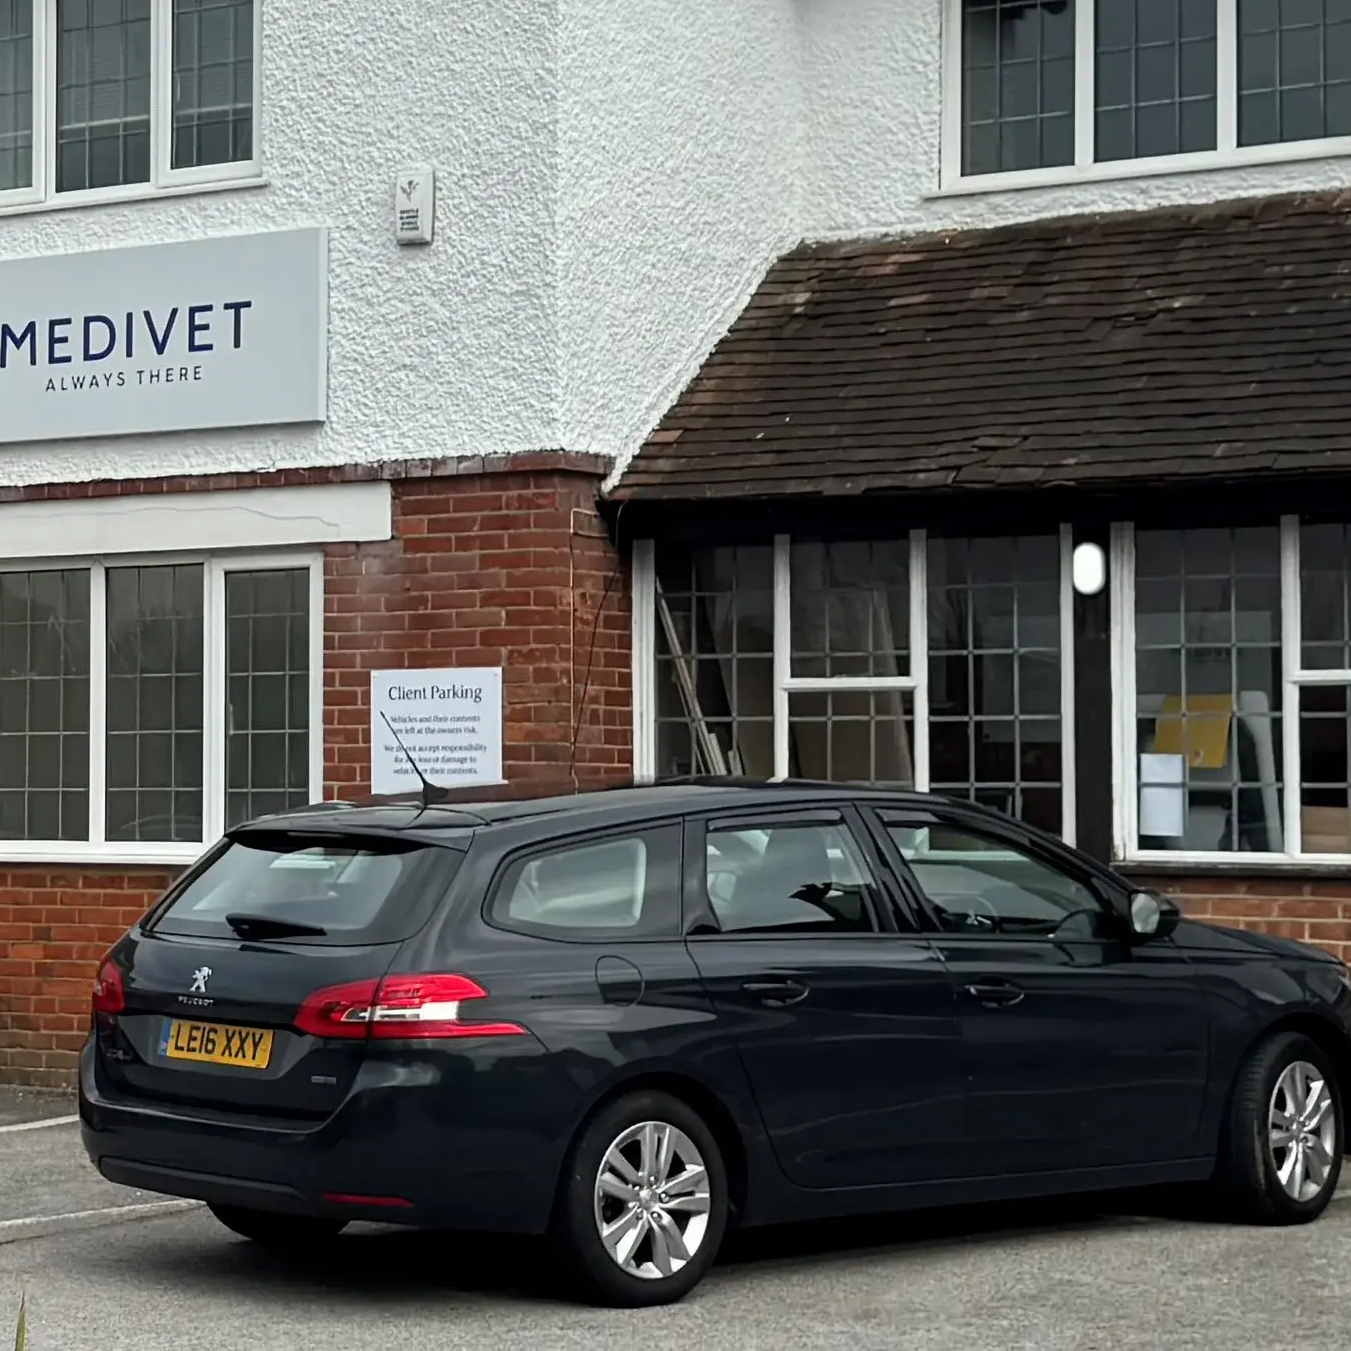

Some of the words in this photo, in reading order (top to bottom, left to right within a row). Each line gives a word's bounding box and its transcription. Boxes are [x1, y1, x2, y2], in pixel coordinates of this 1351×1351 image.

[0, 300, 253, 369] MEDIVET
[45, 371, 126, 393] ALWAYS
[136, 365, 203, 385] THERE
[388, 685, 427, 700] Client
[431, 684, 482, 703] Parking
[173, 1022, 219, 1055] LE16
[221, 1028, 264, 1061] XXY
